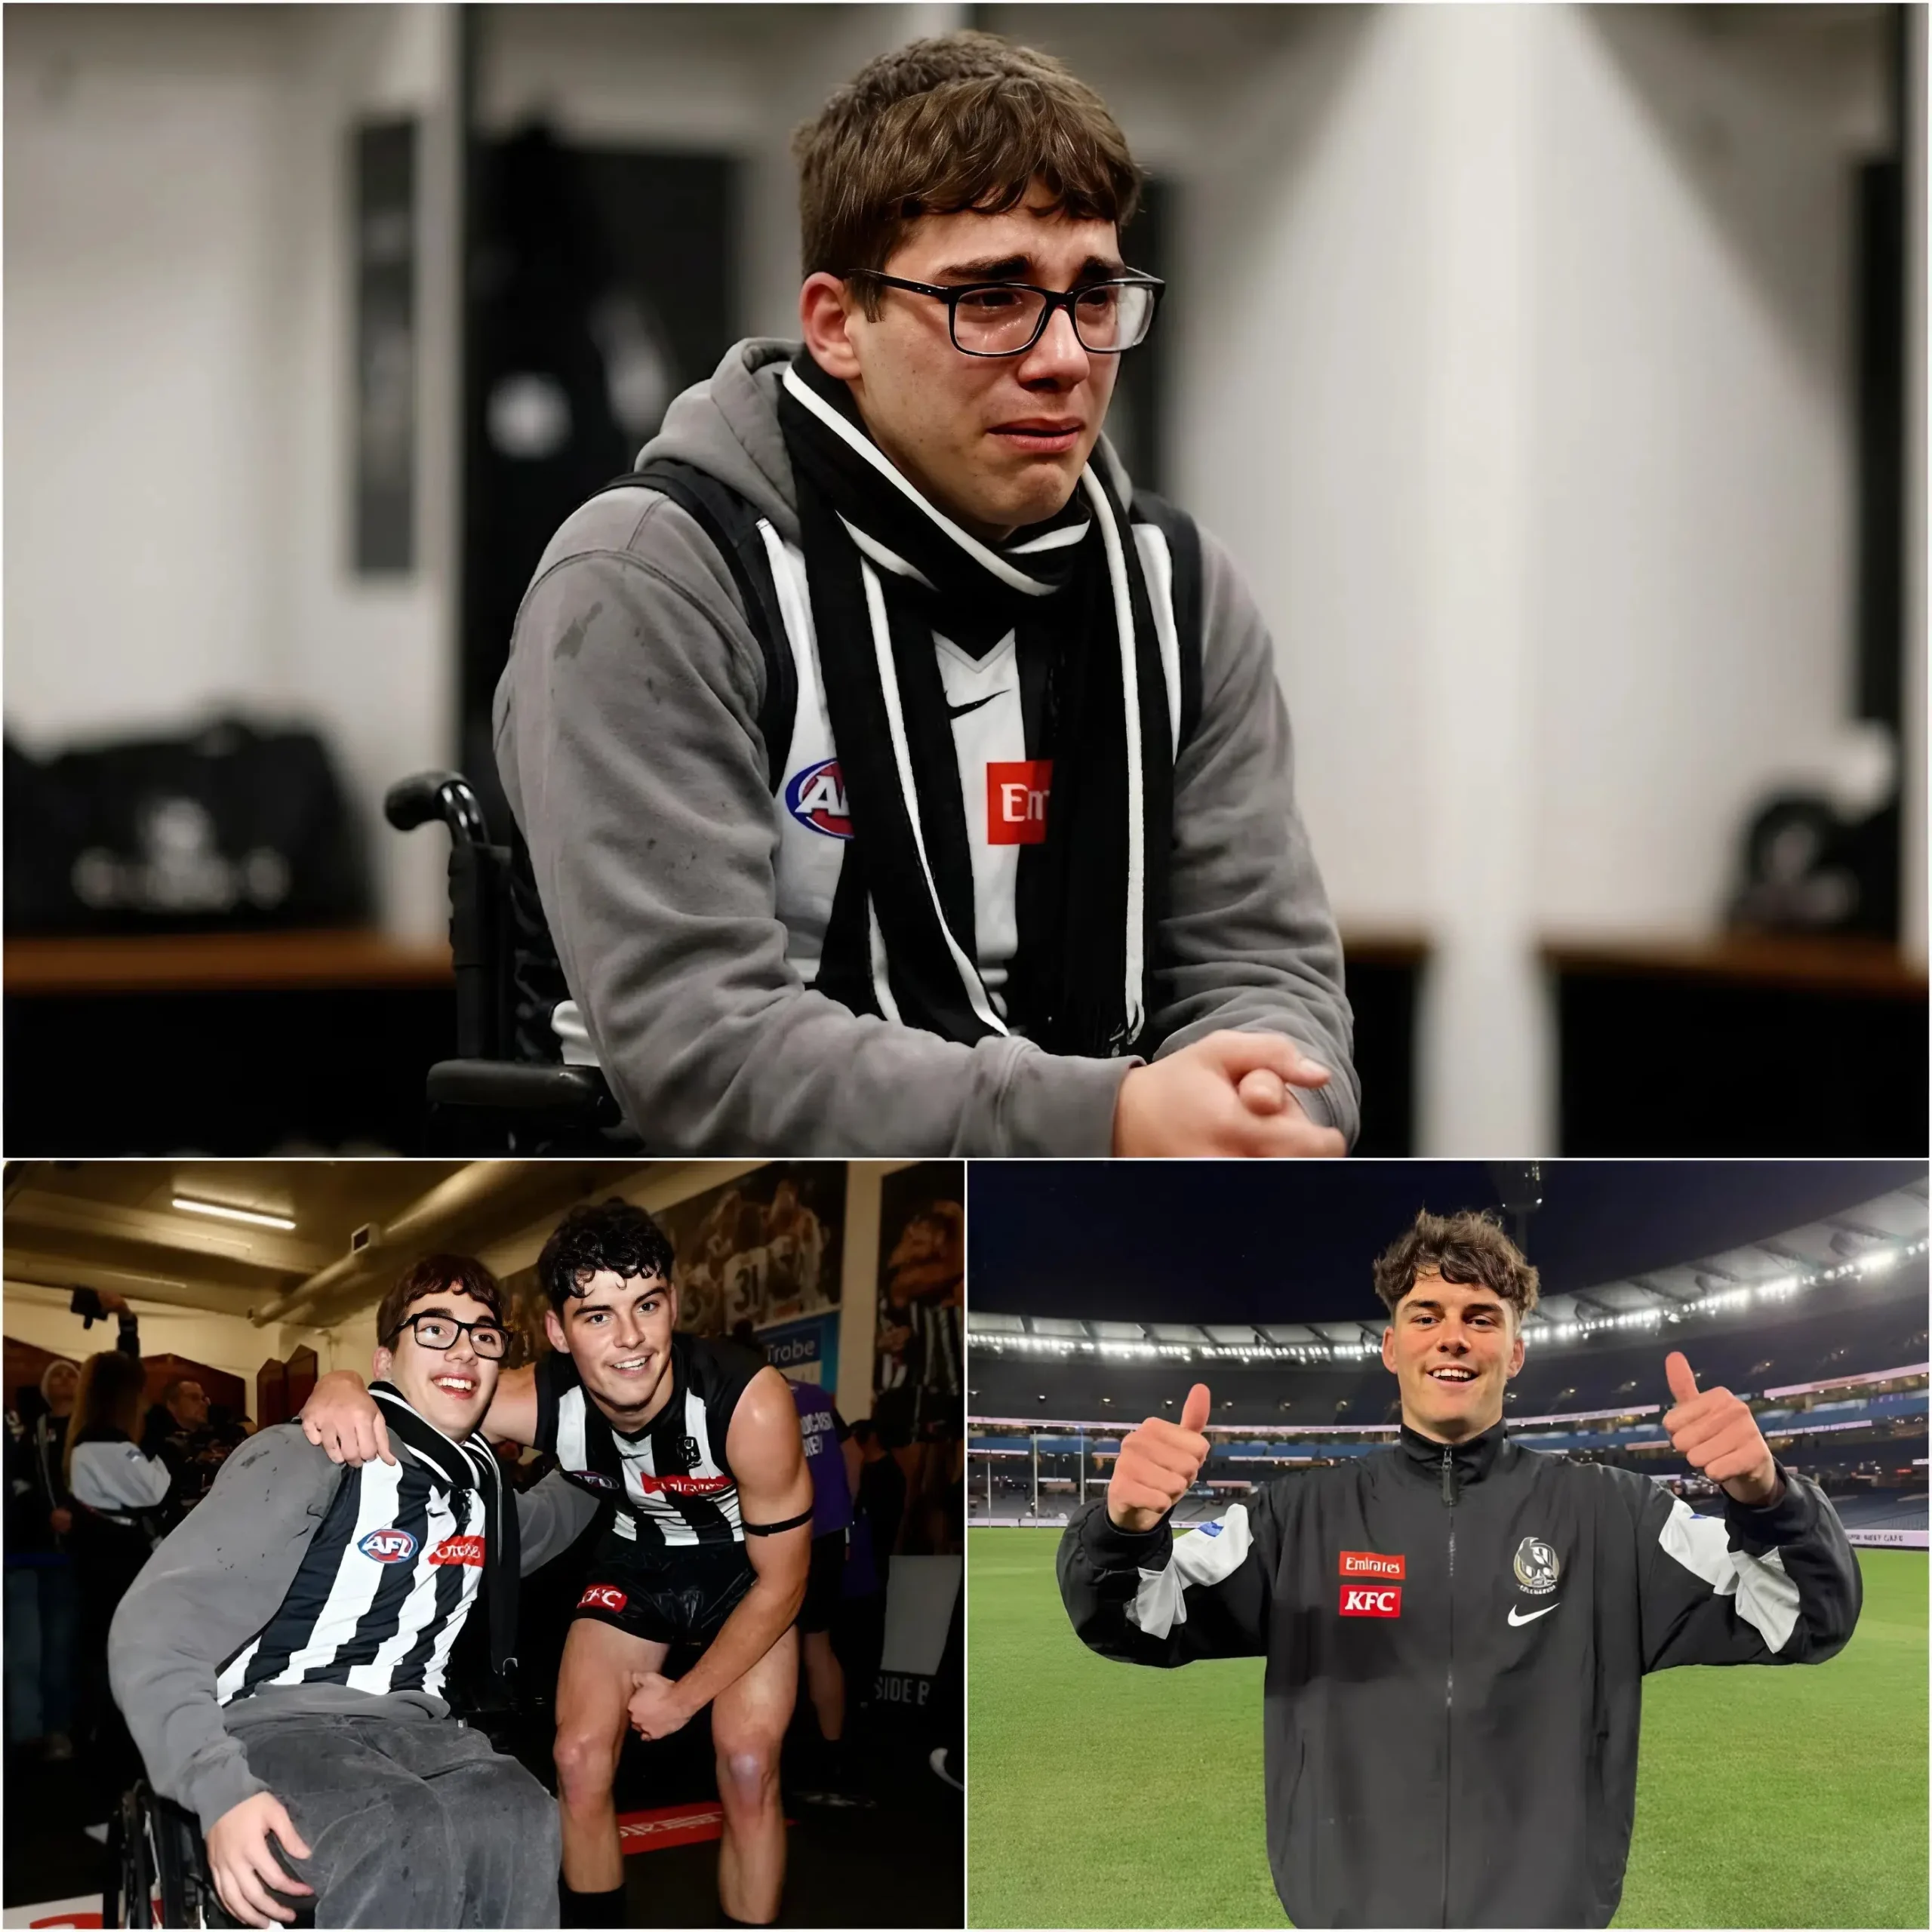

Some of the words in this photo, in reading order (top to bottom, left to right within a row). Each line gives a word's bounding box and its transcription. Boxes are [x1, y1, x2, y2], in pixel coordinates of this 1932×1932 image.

[765, 1339, 816, 1363] Trobe
[362, 1536, 411, 1558] AFL
[1344, 1591, 1395, 1611] KFC
